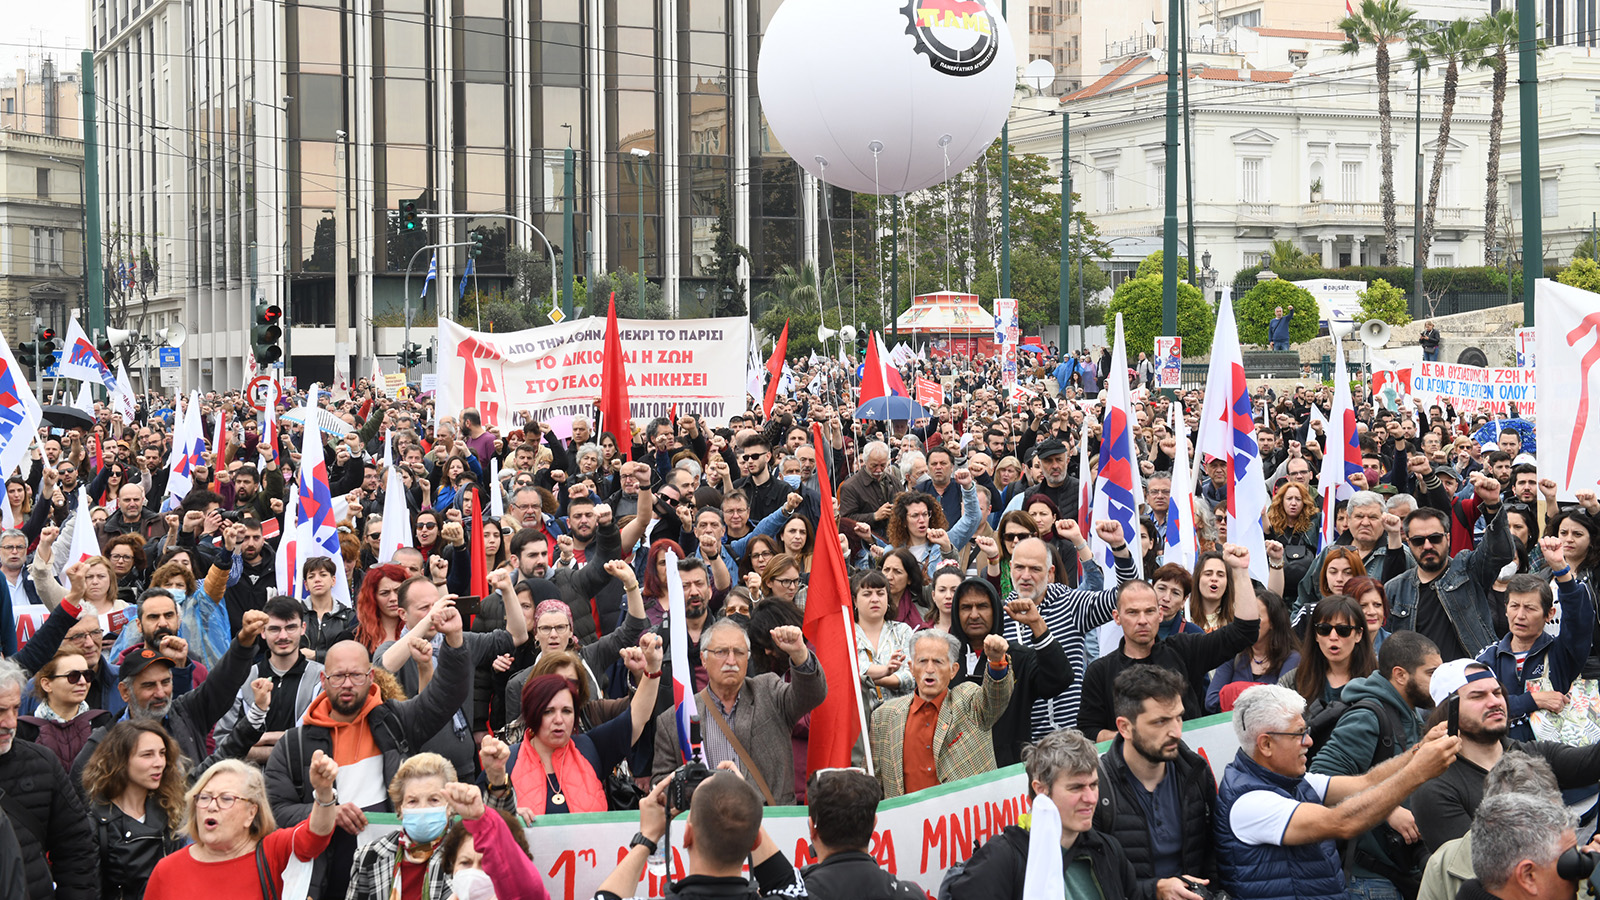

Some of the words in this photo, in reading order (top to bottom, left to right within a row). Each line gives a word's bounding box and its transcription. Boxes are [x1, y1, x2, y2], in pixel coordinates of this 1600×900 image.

[509, 342, 535, 354] ΑΠΟ
[537, 336, 565, 351] ΤΗΝ
[658, 330, 676, 341] ΤΟ
[679, 329, 723, 341] ΠΑΡΙΣΙ
[642, 350, 653, 364] Η
[657, 350, 693, 364] ΖΩΗ
[525, 378, 559, 394] ΣΤΟ
[641, 373, 707, 387] ΝΙΚΗΣΕΙ
[1421, 363, 1431, 377] ΔΕ
[1435, 364, 1445, 378] ΘΑ
[1494, 369, 1520, 383] ΖΩΗ
[1414, 377, 1424, 391] ΟΙ
[1427, 378, 1456, 395] ΑΓΩΝΕΣ
[1499, 385, 1529, 400] ΟΛΟΥ
